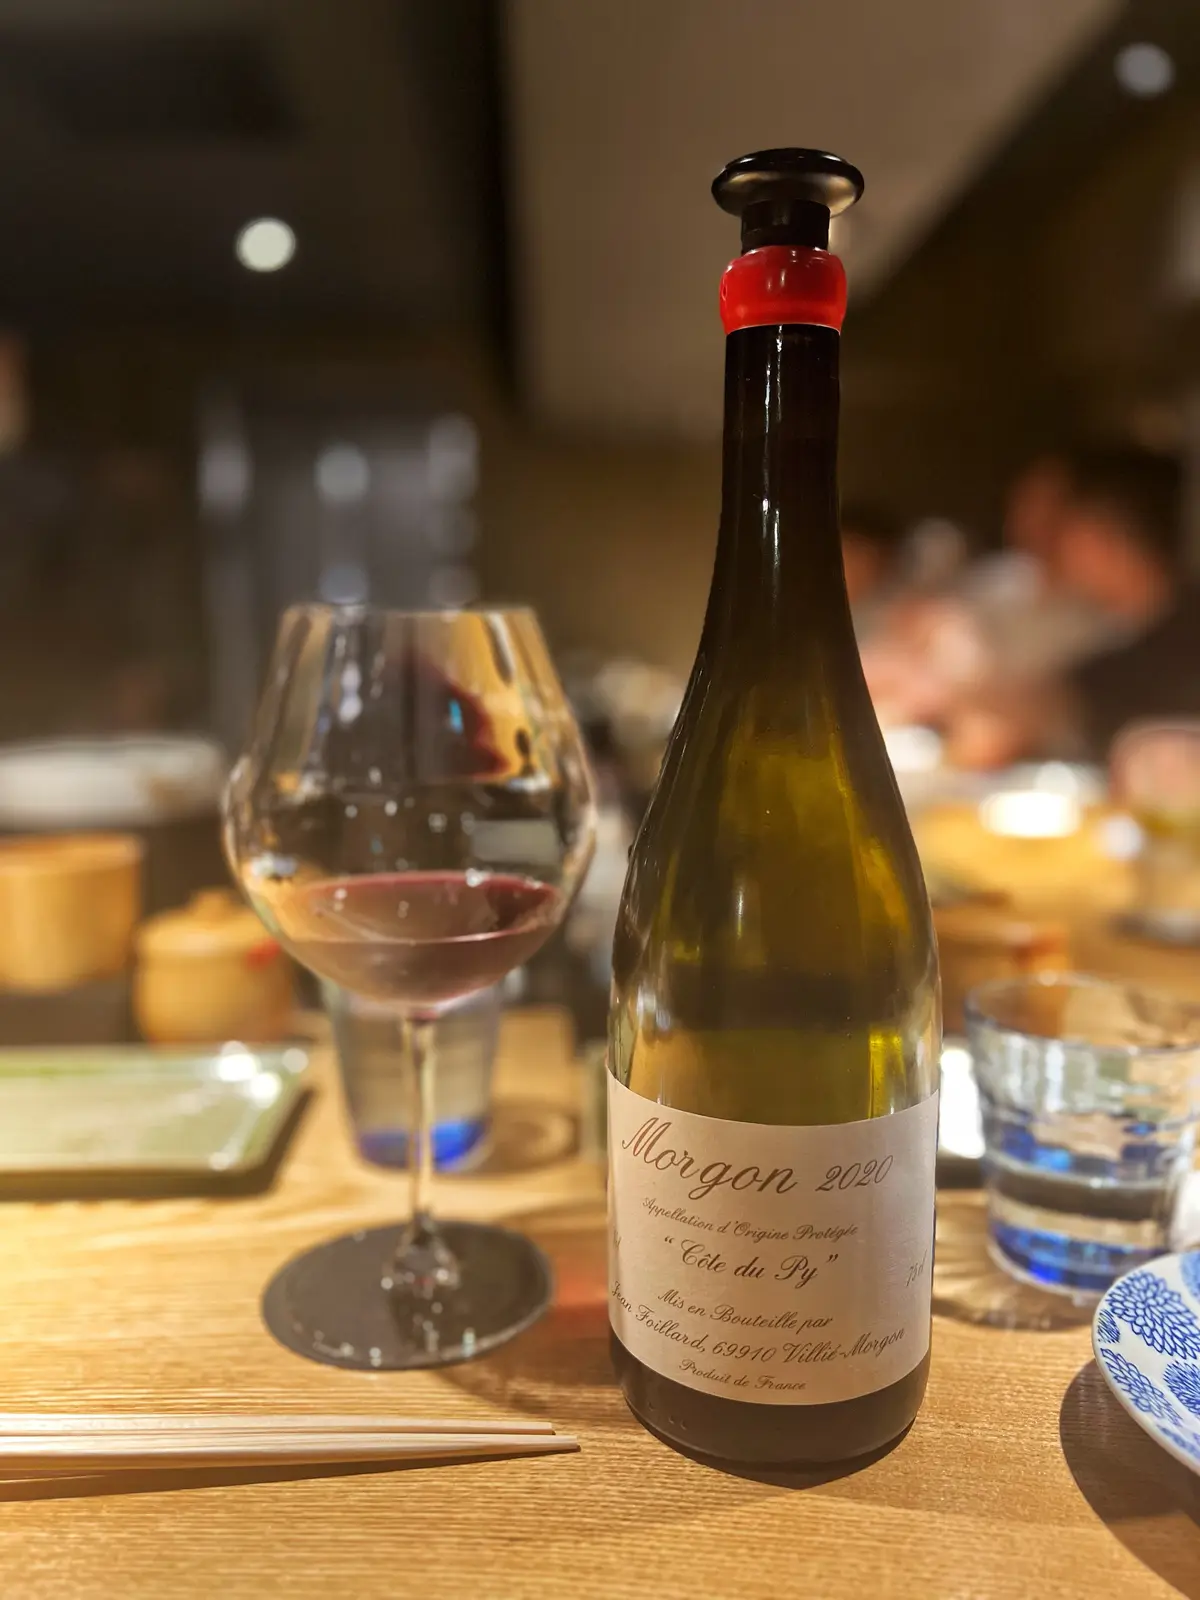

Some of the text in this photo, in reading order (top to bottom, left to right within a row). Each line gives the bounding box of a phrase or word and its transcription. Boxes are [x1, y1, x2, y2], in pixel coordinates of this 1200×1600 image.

[621, 1116, 894, 1201] Morgon 2020
[642, 1196, 714, 1232] Appellation
[792, 1223, 859, 1243] Protégée
[733, 1256, 766, 1279] du
[611, 1280, 905, 1365] Jean Foillard, 69910 Villié-Morgon
[657, 1289, 834, 1335] Mis en Bouteille par
[678, 1358, 807, 1391] Produit de France
